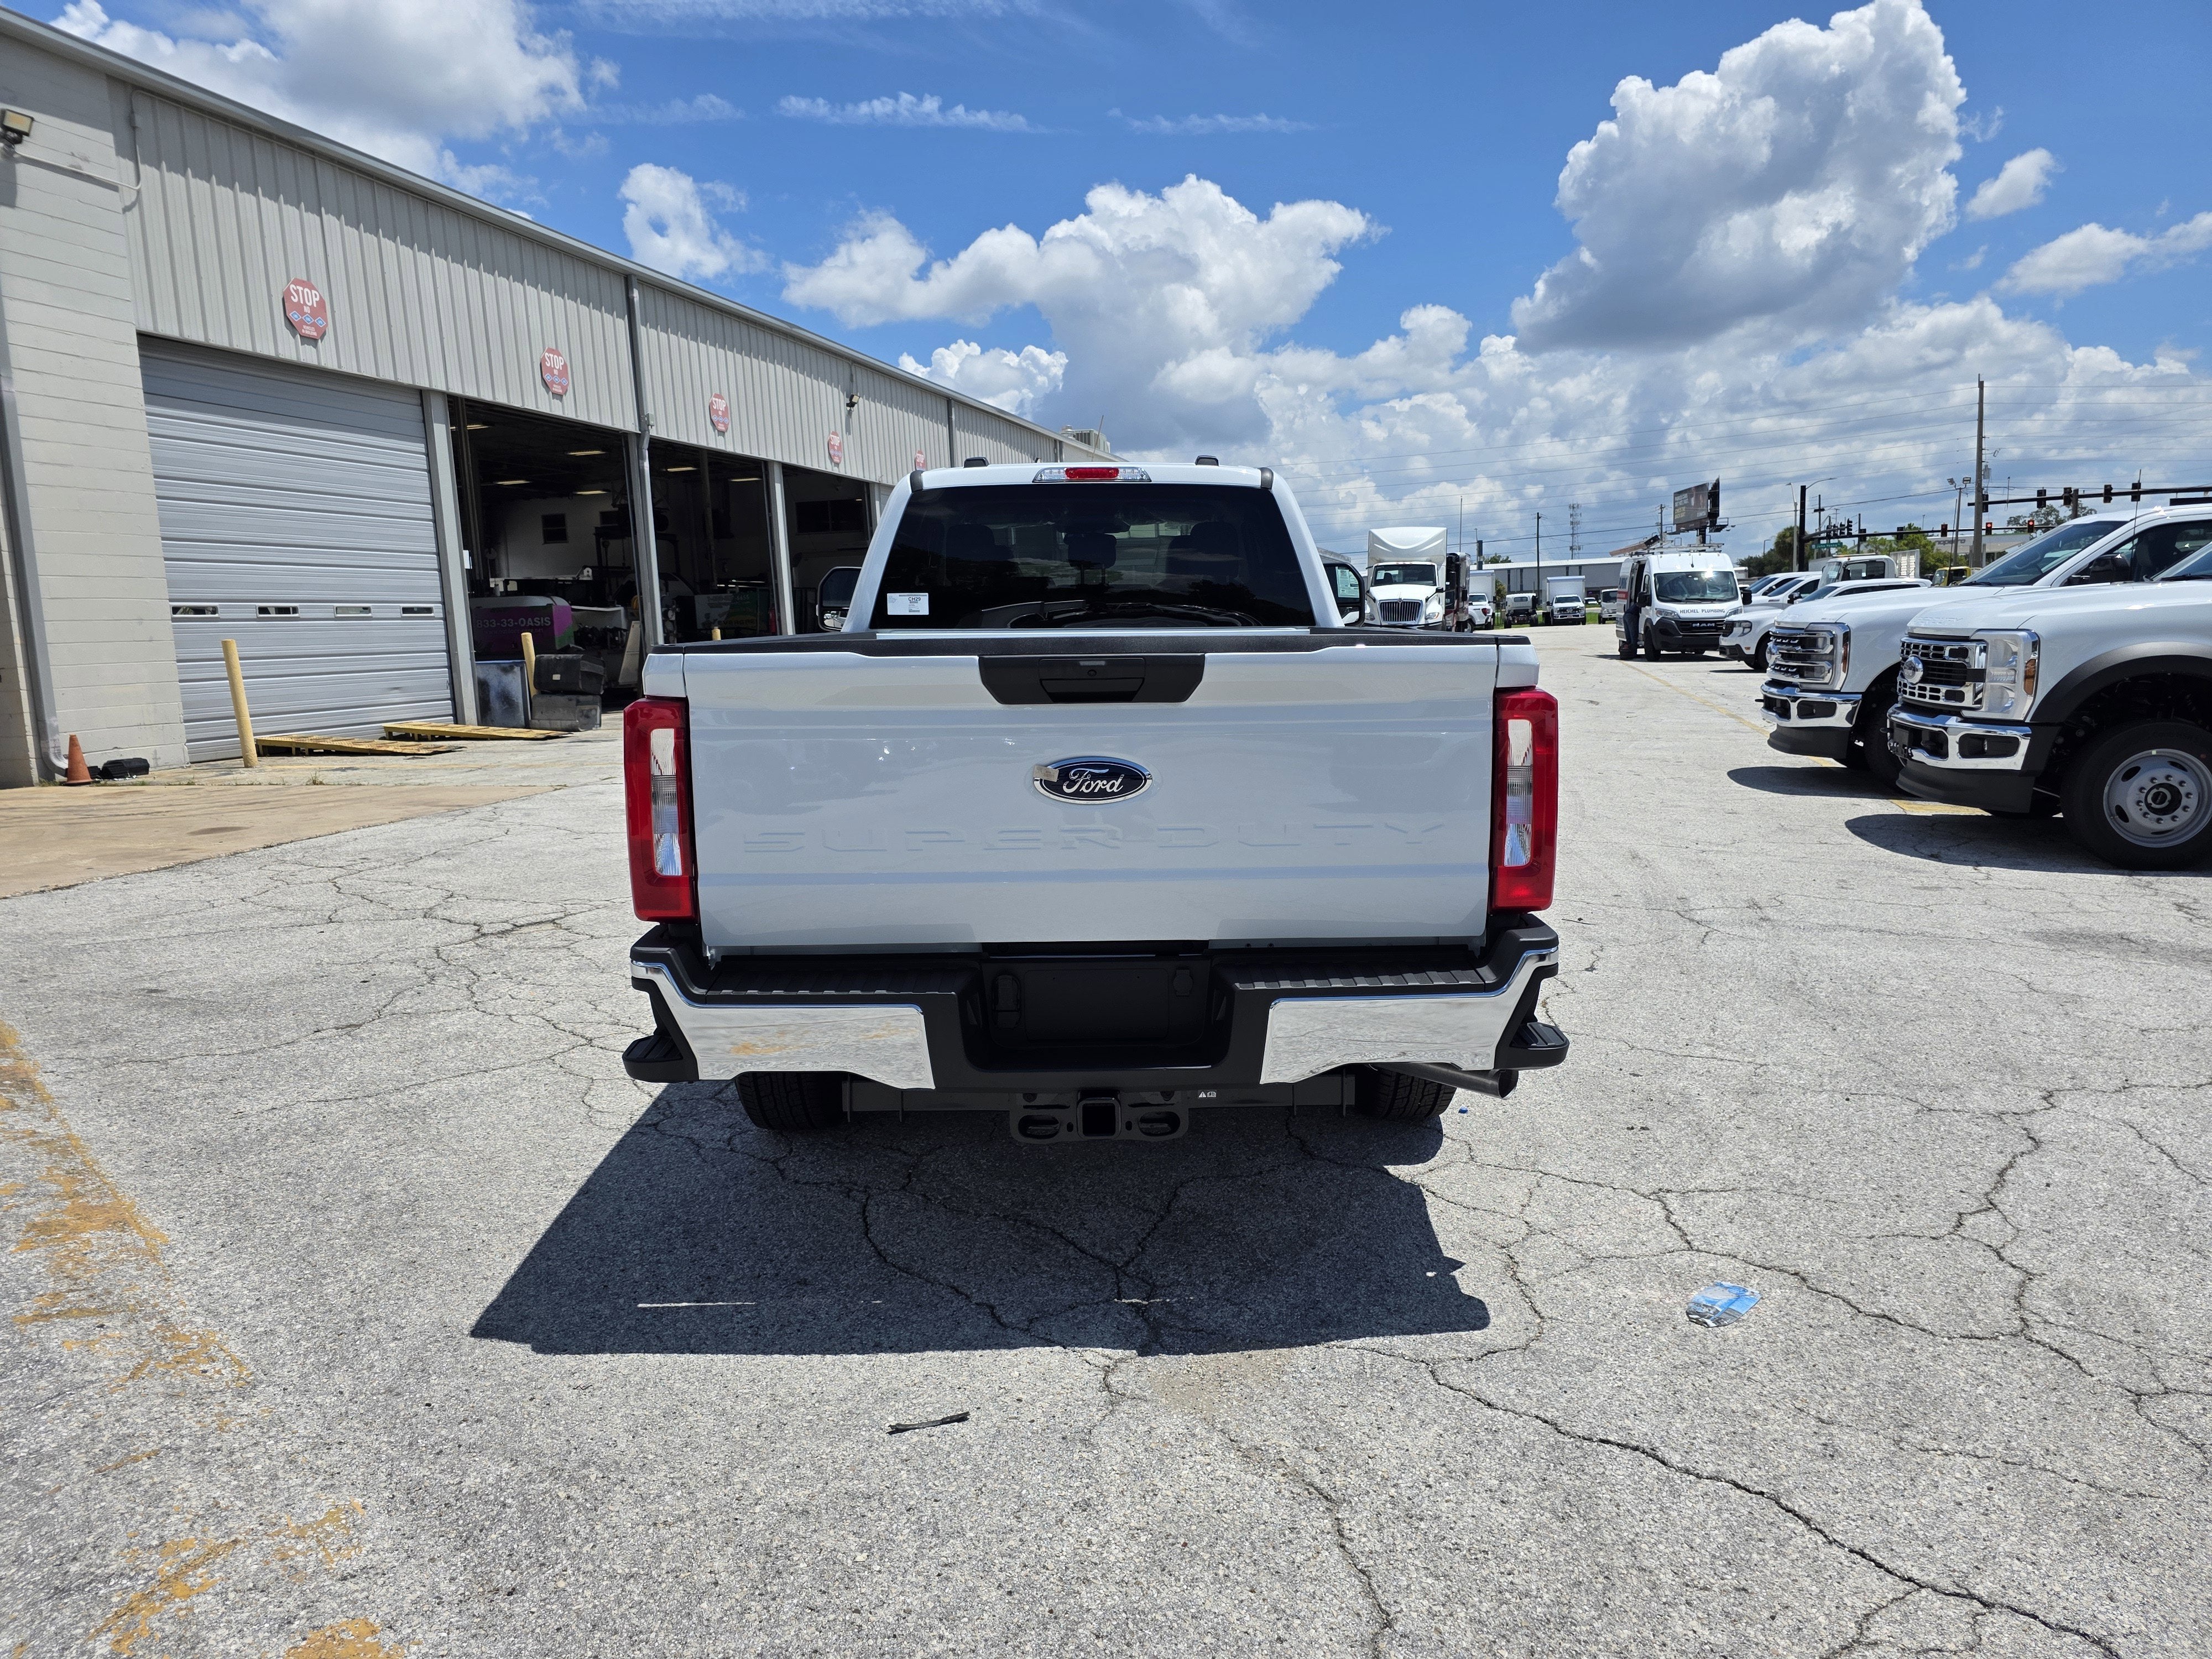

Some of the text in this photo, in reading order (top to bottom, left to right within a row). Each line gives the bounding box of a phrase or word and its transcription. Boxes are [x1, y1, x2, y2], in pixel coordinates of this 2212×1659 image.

[290, 284, 320, 307] STOP
[304, 305, 310, 314] NO
[545, 352, 564, 371] STOP
[713, 397, 726, 411] STOP
[1062, 767, 1125, 794] Ford
